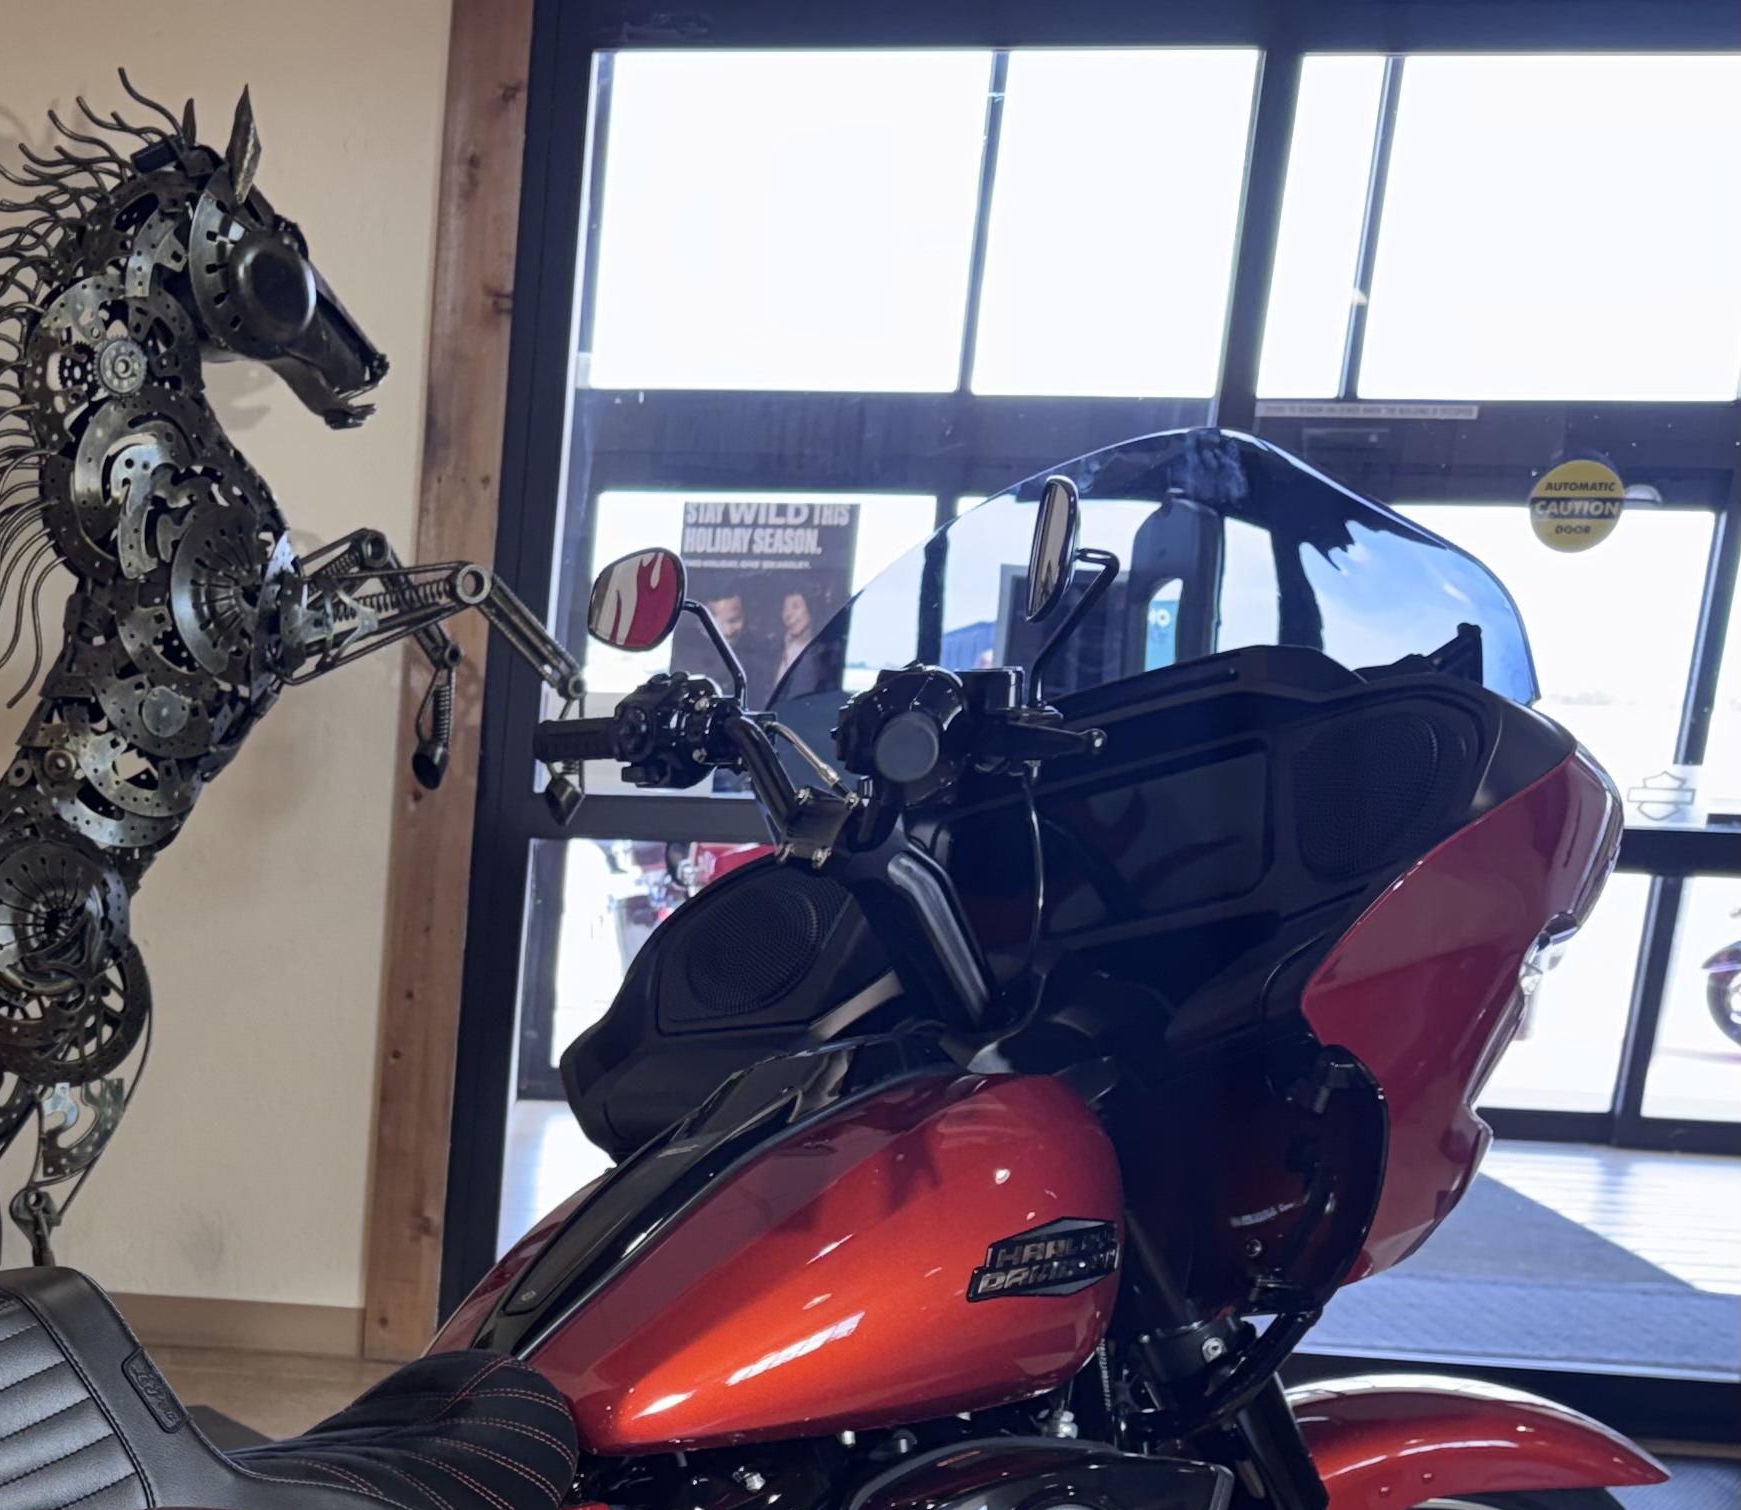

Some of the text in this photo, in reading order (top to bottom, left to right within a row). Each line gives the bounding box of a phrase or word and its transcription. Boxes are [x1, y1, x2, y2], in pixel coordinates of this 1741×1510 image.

[1544, 482, 1616, 492] AUTOMATIC
[686, 502, 851, 527] STAY WILD THIS
[1535, 500, 1619, 516] CAUTION
[1555, 525, 1592, 535] DOOR
[684, 527, 822, 555] HOLIDAY SEASON.
